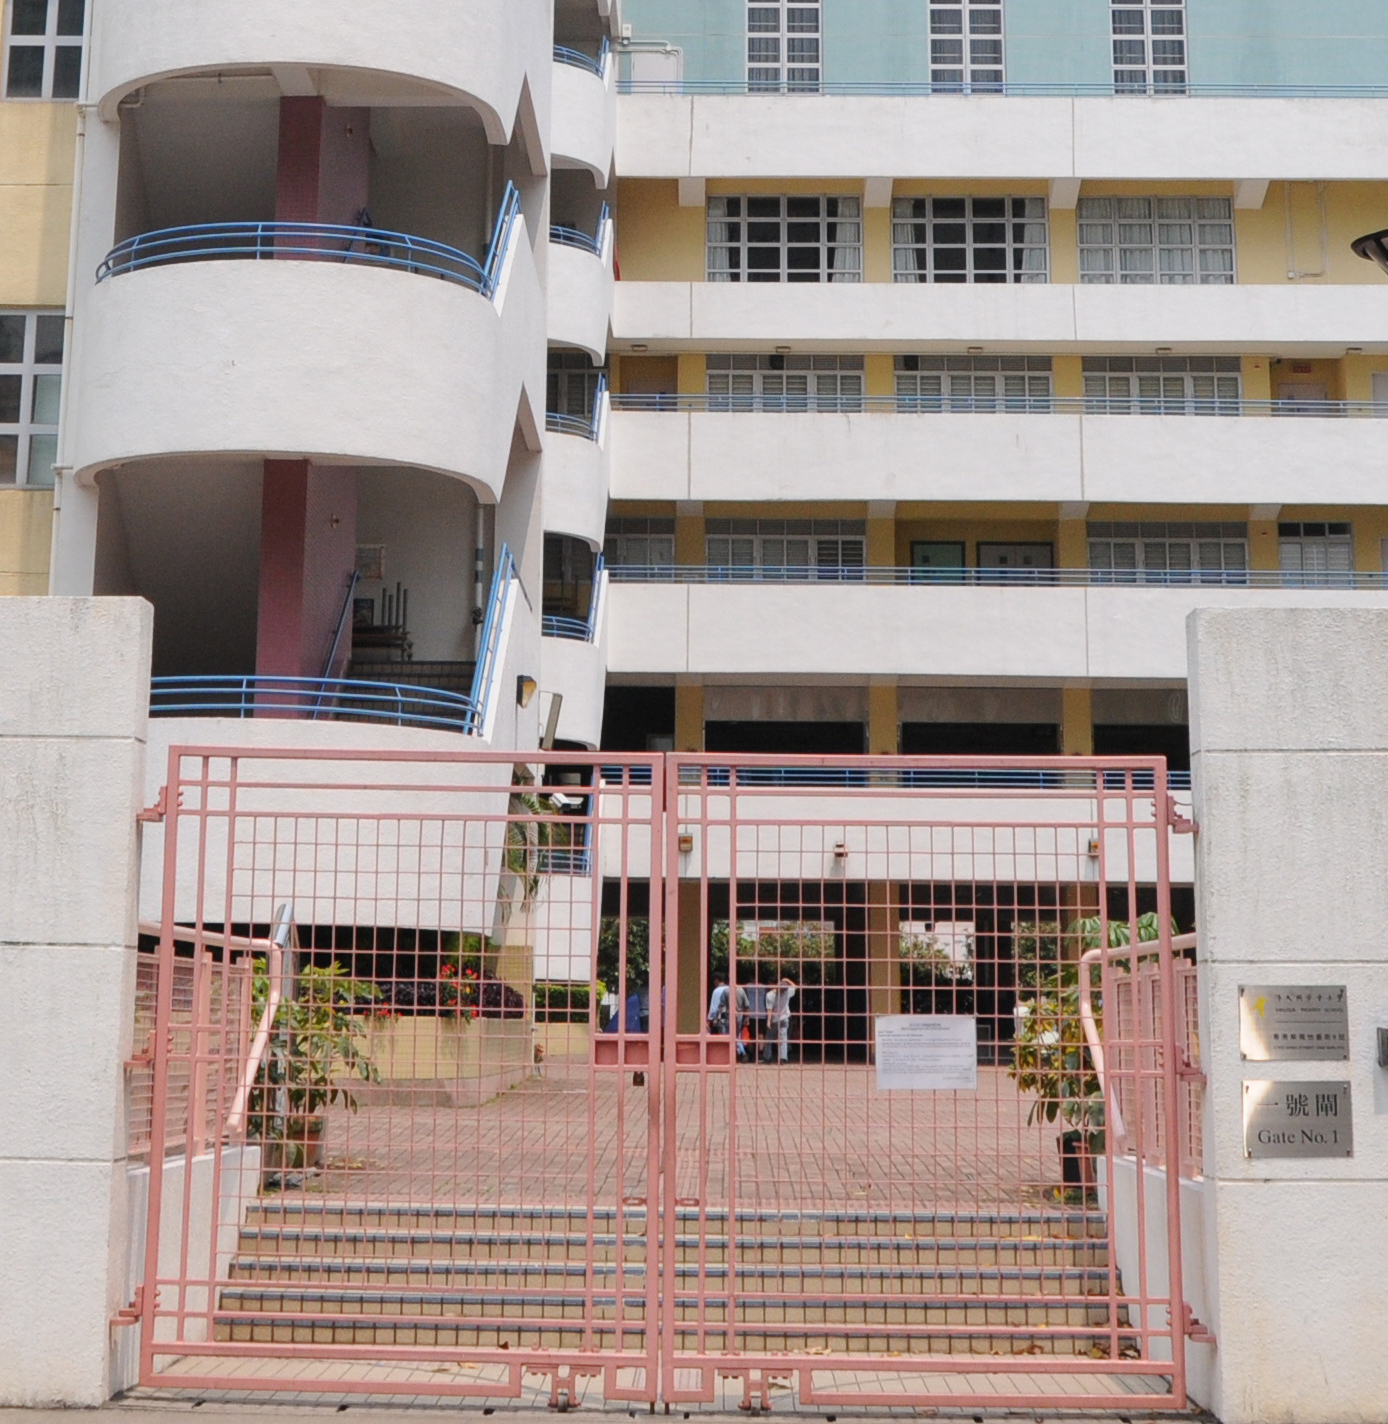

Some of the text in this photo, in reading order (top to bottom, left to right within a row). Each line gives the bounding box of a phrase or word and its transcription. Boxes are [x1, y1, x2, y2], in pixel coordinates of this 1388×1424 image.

[1256, 1093, 1338, 1117] 一號閘
[1257, 1128, 1339, 1144] Gate No. 1
